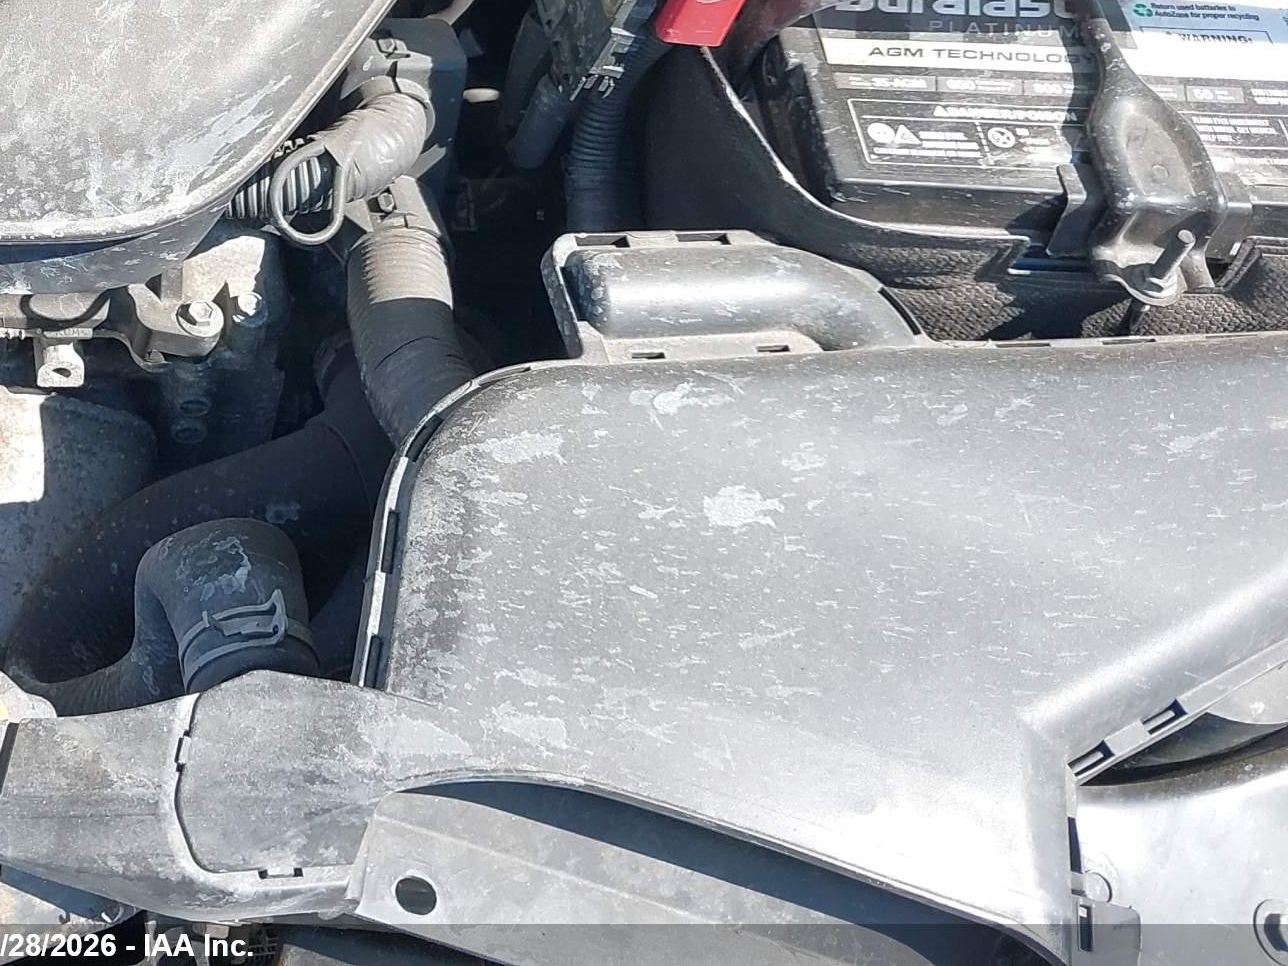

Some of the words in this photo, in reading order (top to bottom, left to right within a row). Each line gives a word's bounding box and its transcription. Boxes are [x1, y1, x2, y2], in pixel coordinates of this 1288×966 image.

[928, 20, 1081, 39] PLATINUM
[869, 46, 923, 58] AGM
[933, 48, 1095, 64] TECHNOLOGY
